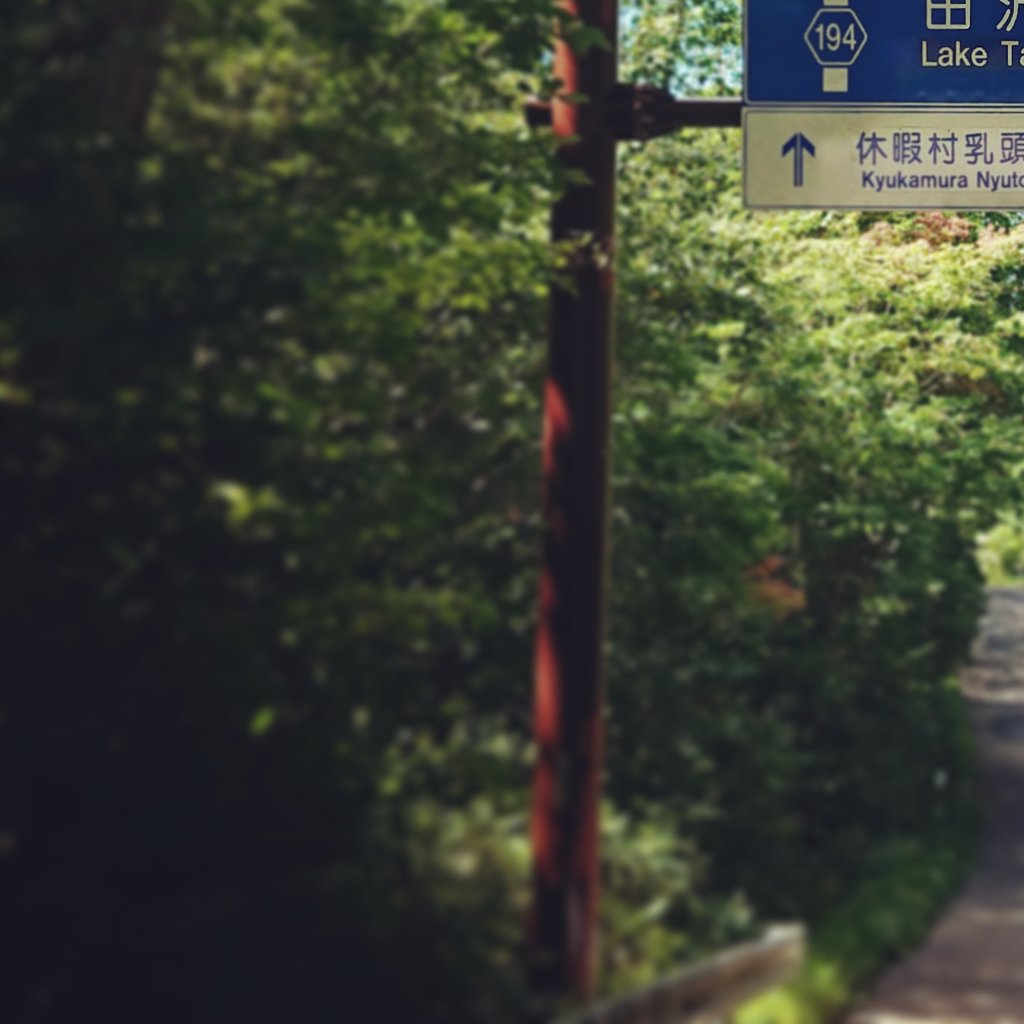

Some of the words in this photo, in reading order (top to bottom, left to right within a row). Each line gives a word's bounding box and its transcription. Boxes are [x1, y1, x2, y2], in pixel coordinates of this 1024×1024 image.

[814, 22, 857, 53] 194
[922, 40, 988, 67] Lake
[861, 170, 969, 193] Kyukamura
